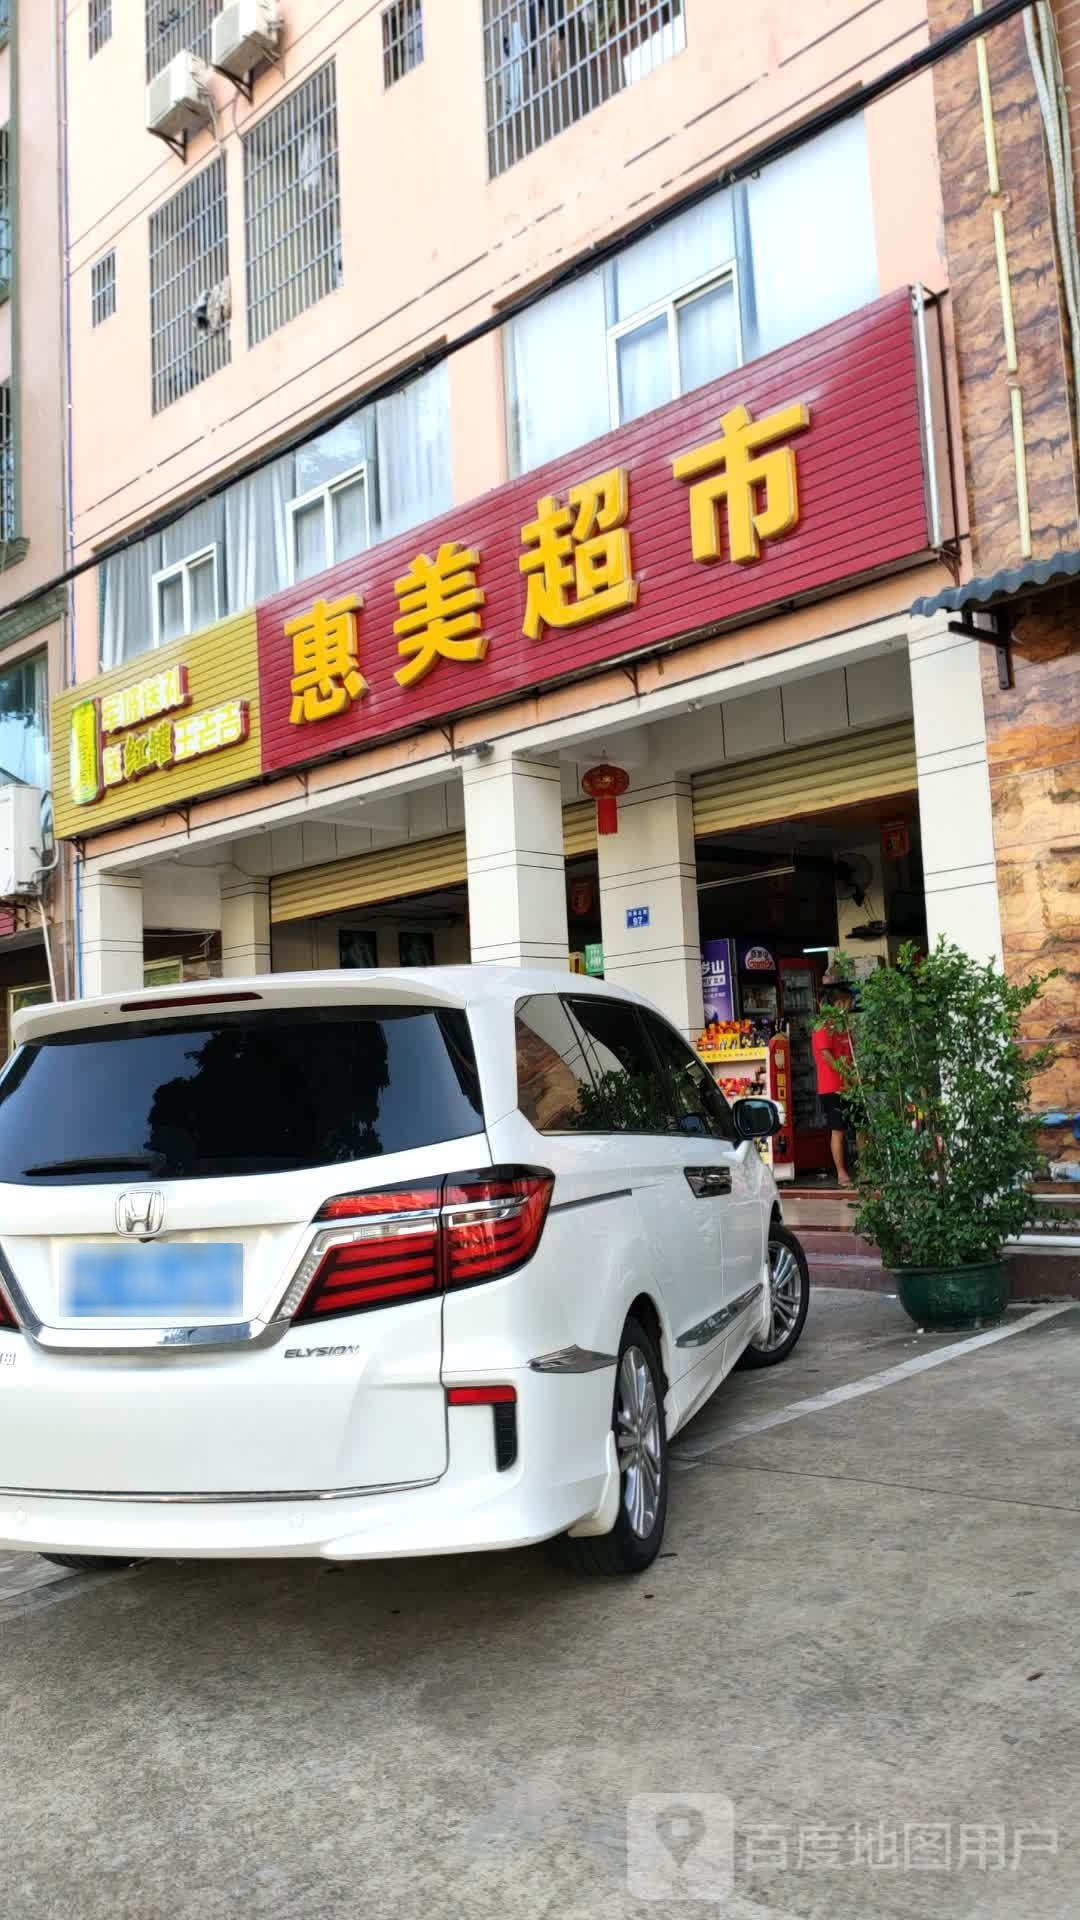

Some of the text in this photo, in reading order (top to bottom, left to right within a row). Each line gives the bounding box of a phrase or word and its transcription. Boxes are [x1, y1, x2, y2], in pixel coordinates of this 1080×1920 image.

[284, 402, 811, 726] 惠美超市
[632, 916, 643, 926] 97
[284, 1344, 360, 1359] ELYSION
